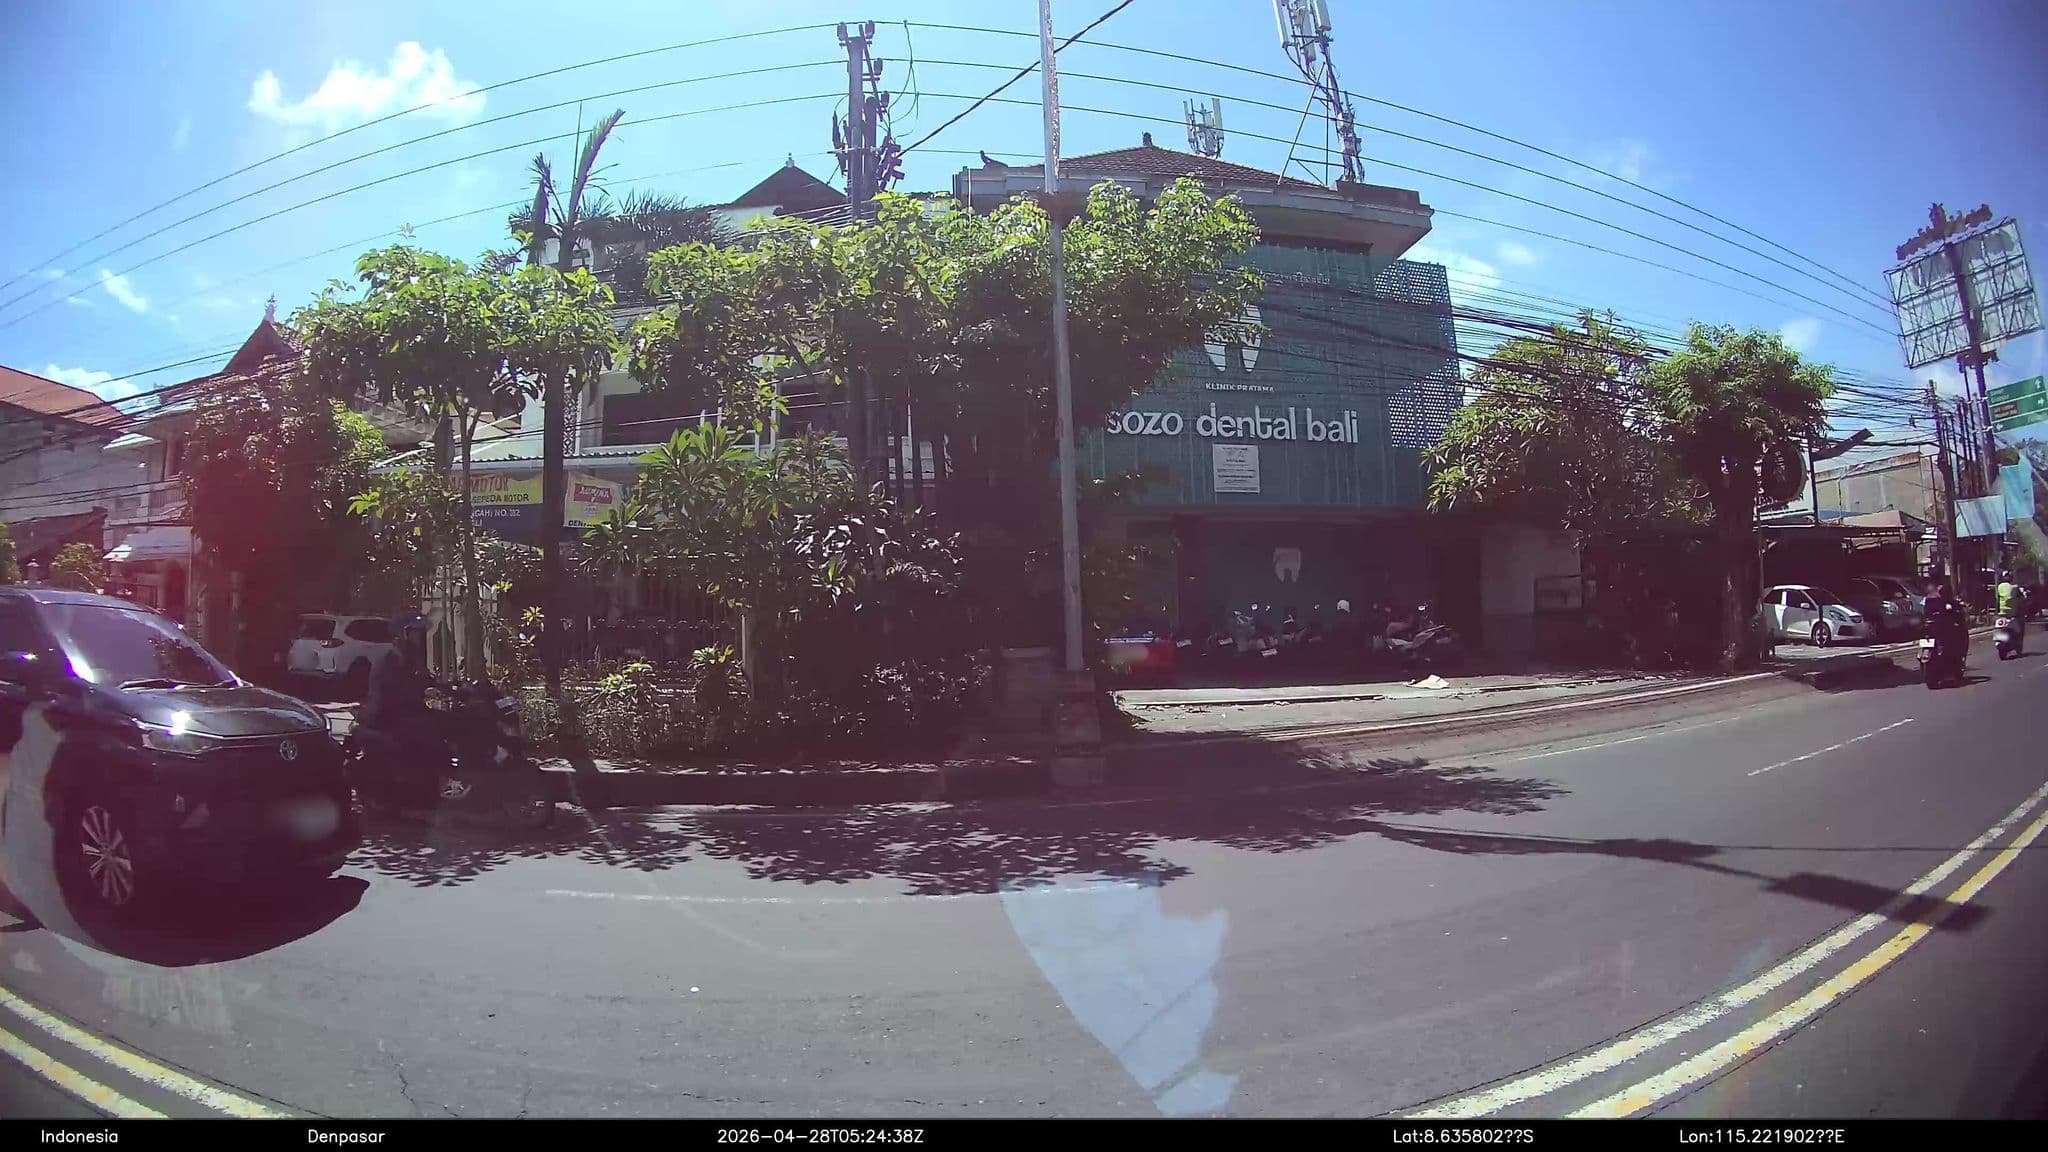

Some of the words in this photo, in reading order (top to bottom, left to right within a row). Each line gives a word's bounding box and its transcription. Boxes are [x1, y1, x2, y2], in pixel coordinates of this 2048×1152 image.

[1205, 382, 1236, 391] KLINIK
[1237, 384, 1274, 392] PRATAMA
[1106, 410, 1183, 436] sozo
[1196, 402, 1297, 441] dental
[1306, 408, 1359, 443] bali
